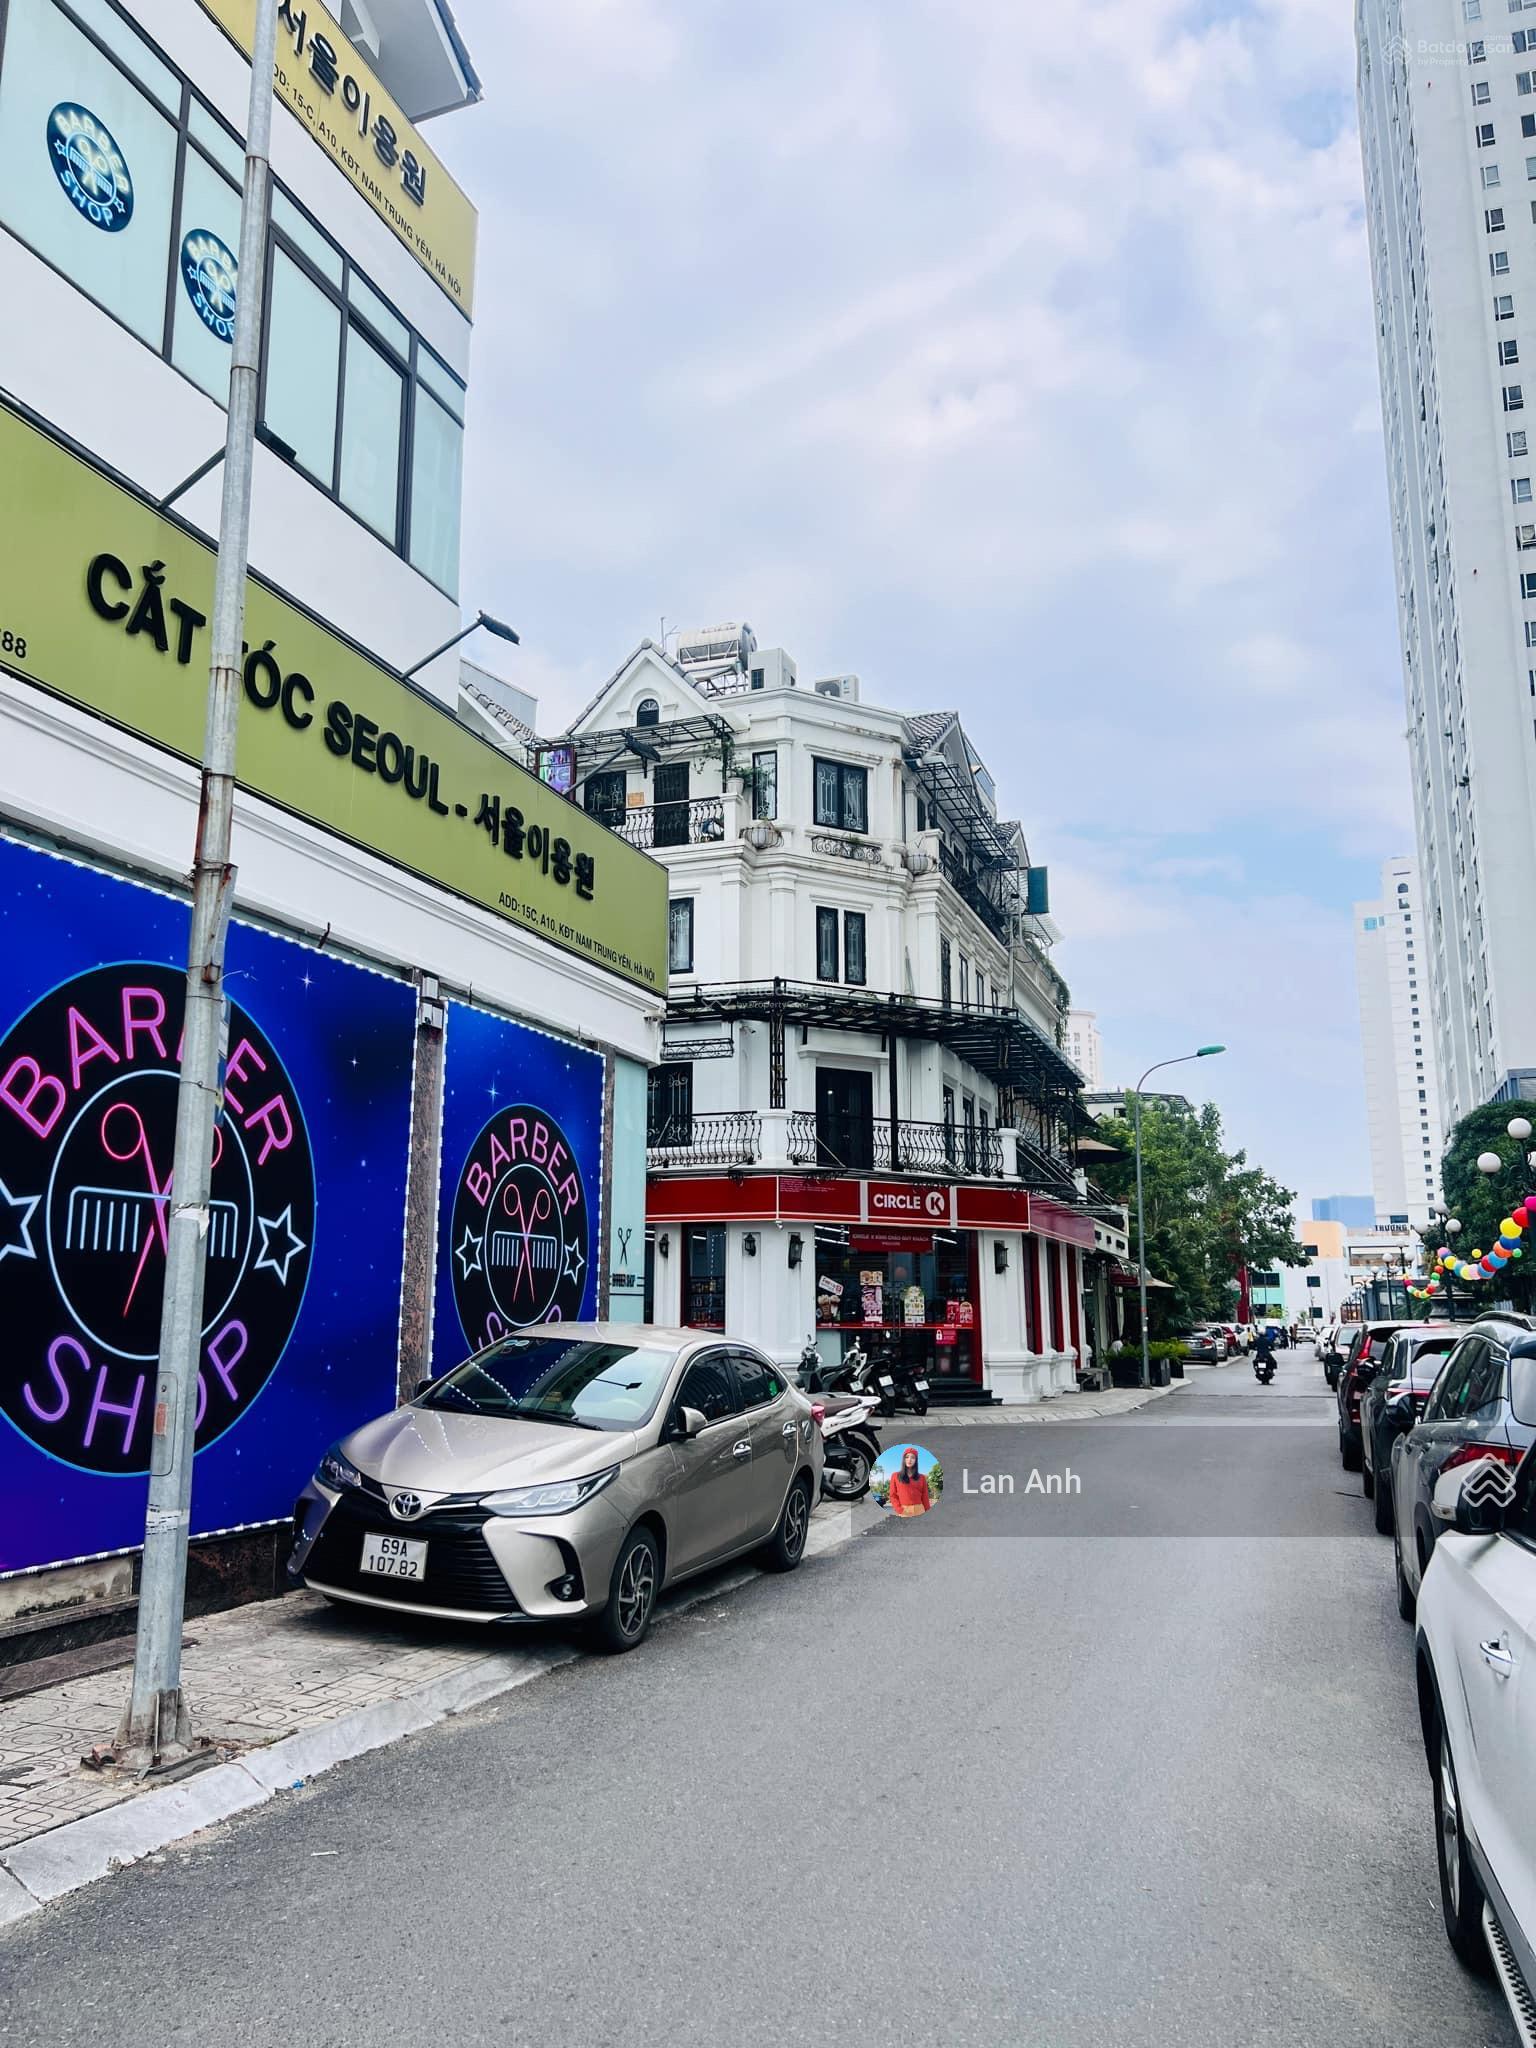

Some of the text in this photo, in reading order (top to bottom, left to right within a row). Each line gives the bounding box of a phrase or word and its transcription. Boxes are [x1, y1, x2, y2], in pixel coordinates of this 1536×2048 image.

[55, 110, 130, 192] BARBER
[273, 63, 290, 91] DD:
[292, 88, 316, 125] 15-C,
[318, 121, 339, 153] A10,
[340, 147, 360, 175] KĐT
[361, 172, 382, 203] NAM
[383, 196, 413, 239] TRUNG
[60, 169, 113, 227] SHOP
[186, 236, 238, 280] BARB
[0, 628, 27, 659] 88
[87, 553, 207, 664] CẮT
[242, 639, 315, 729] ÓC
[324, 700, 449, 816] SEOUL
[474, 793, 594, 901] 서울이용원
[498, 892, 520, 913] ADD:
[522, 905, 539, 925] 15C,
[540, 914, 558, 935] A10,
[559, 922, 575, 941] KĐT
[575, 931, 592, 950] NAM
[593, 941, 617, 963] TRUNG
[0, 986, 294, 1166] BARER
[466, 1118, 579, 1216] BARBER
[873, 1193, 943, 1215] CIRCLE K
[478, 1303, 562, 1351] SP
[23, 1319, 250, 1455] SHP
[369, 1555, 418, 1577] 107.82
[381, 1538, 408, 1557] 69A
